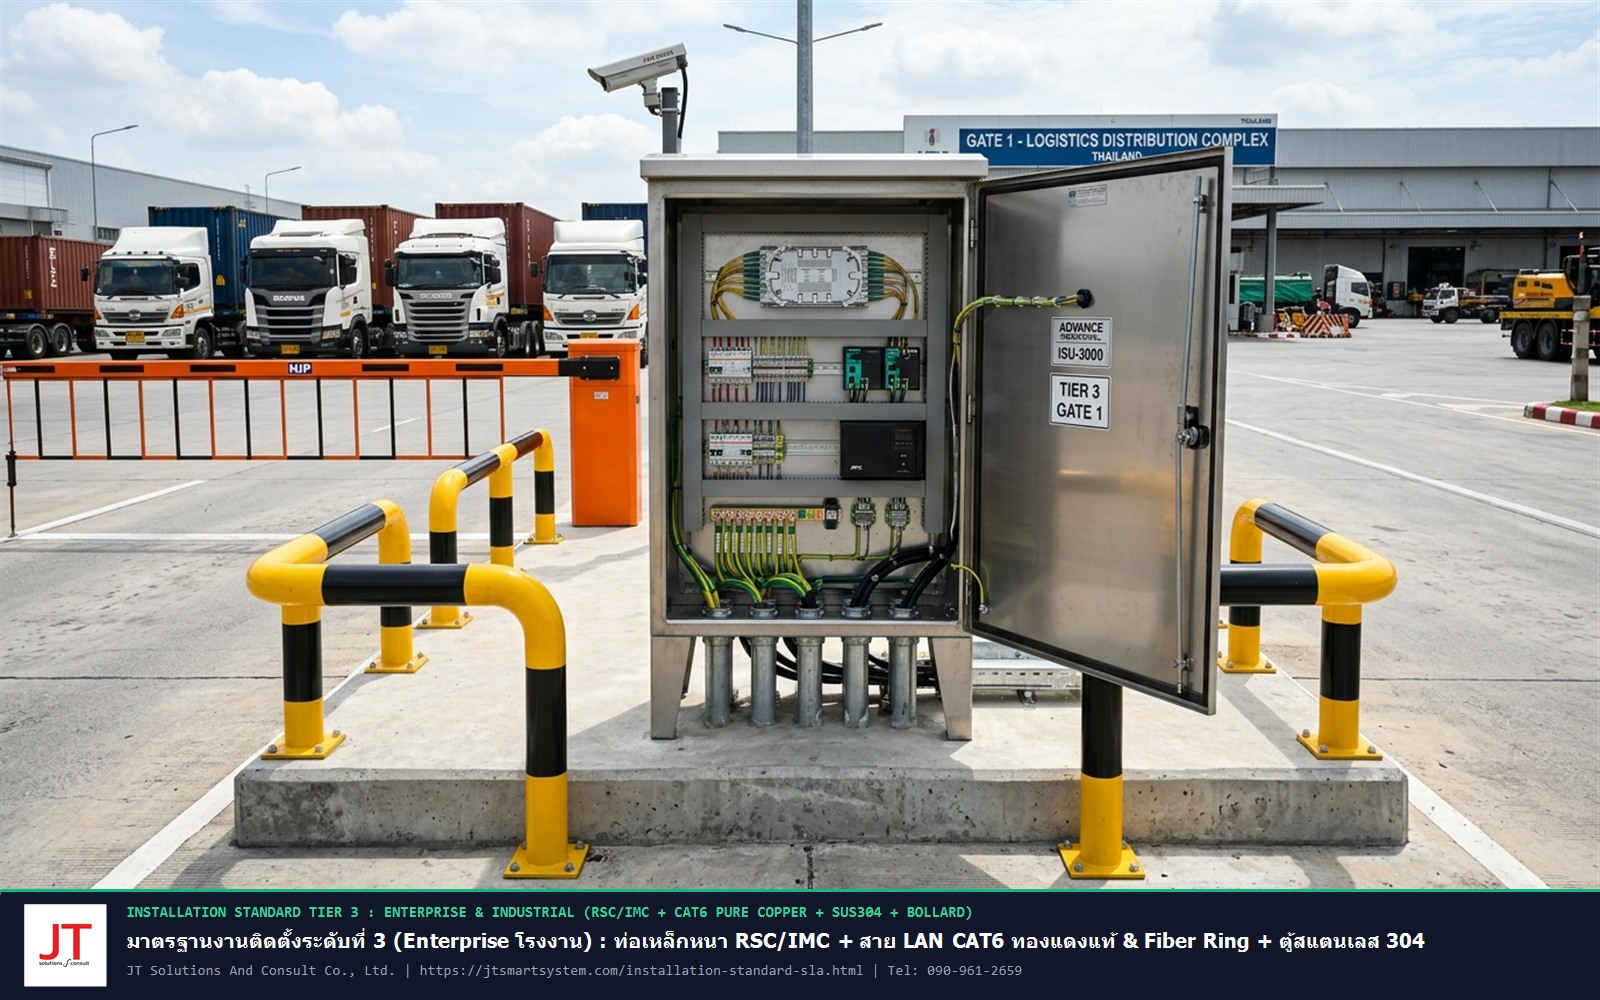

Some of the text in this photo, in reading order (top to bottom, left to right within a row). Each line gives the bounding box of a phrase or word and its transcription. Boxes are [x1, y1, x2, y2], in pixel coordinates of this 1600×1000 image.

[967, 133, 1003, 148] GATE
[1007, 133, 1013, 148] 1
[1026, 132, 1099, 148] LOGISTICS
[1102, 132, 1198, 148] DISTRIBUTION
[1201, 132, 1269, 147] COMPLEX
[1091, 151, 1143, 162] THAILAND
[1059, 321, 1104, 333] ADVANCE
[1058, 347, 1104, 361] ISU-3000
[1060, 381, 1100, 399] TIER 3
[1057, 402, 1102, 421] GATE 1
